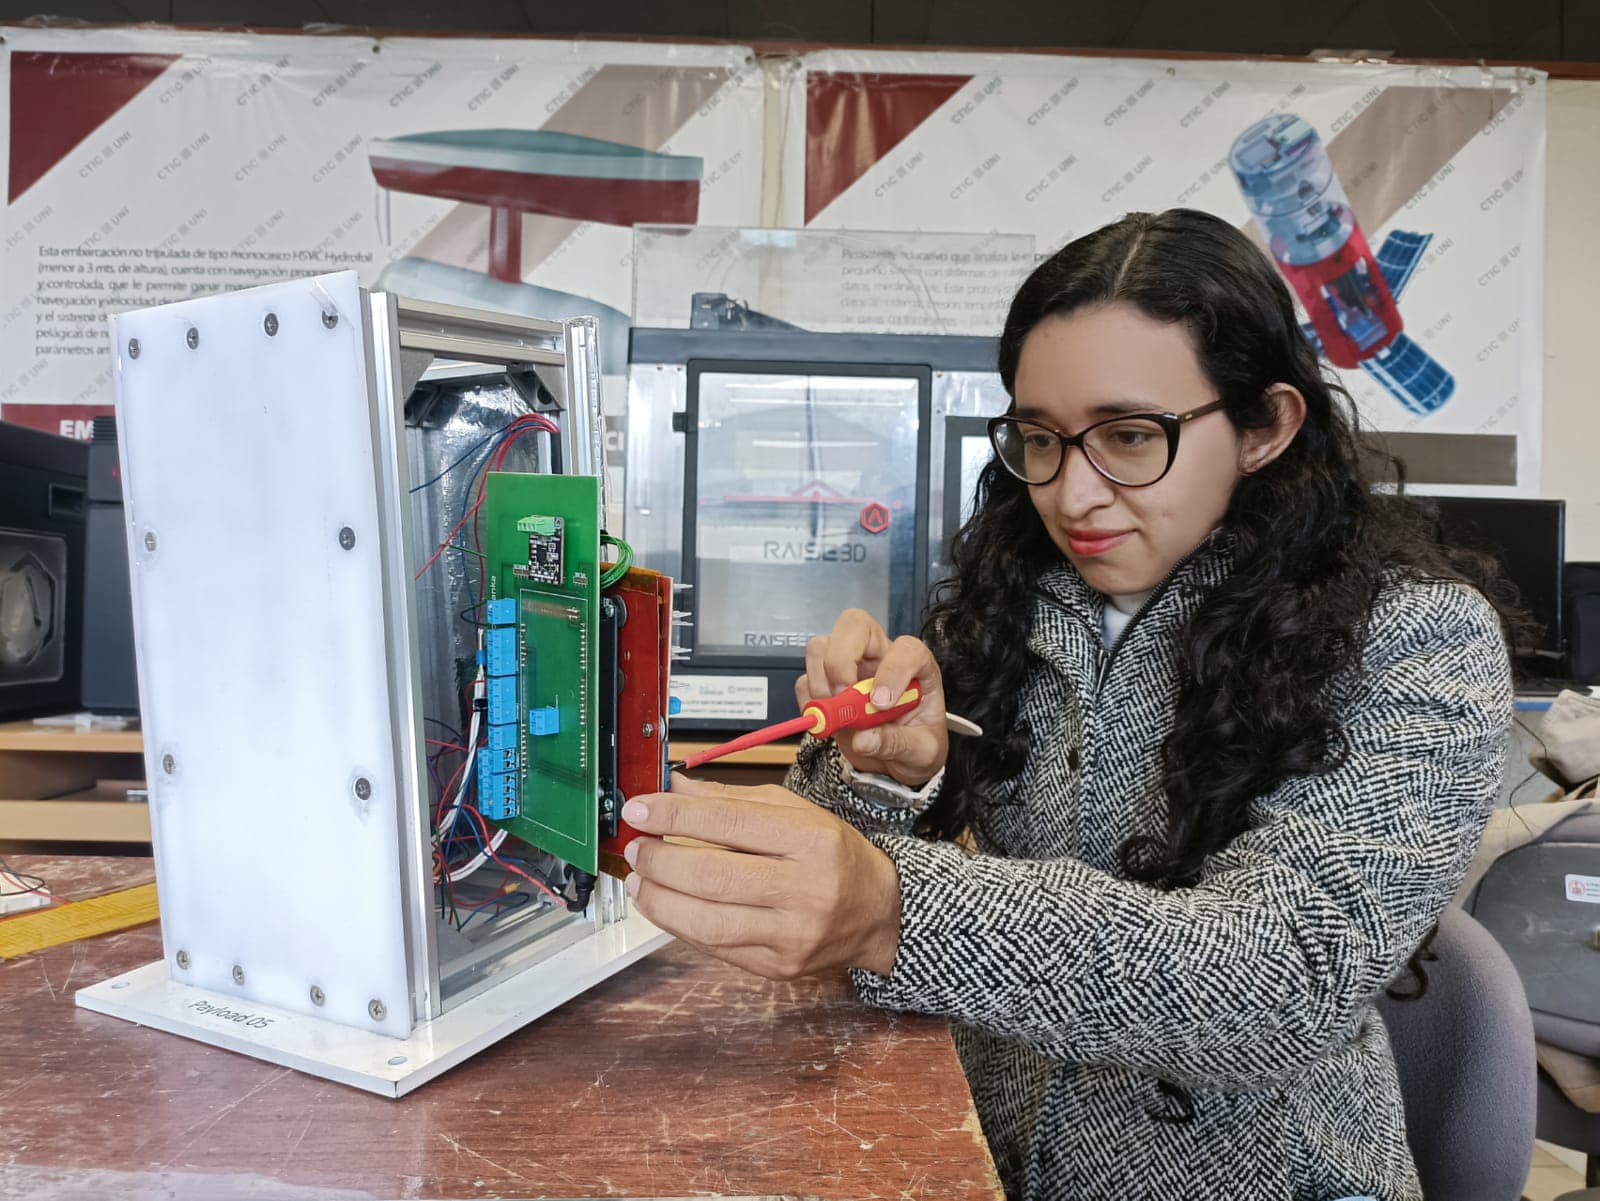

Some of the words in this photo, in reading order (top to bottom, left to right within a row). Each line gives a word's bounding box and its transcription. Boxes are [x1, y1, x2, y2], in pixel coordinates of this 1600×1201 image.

[389, 85, 415, 108] CTIC
[467, 88, 493, 111] CTIC
[500, 62, 521, 81] UNI
[544, 90, 570, 114] CTIC
[950, 100, 975, 124] CTIC
[1026, 102, 1052, 126] CTIC
[1059, 77, 1080, 96] UNI
[1330, 108, 1355, 133] CTIC
[1361, 86, 1382, 107] UNI
[1103, 103, 1129, 127] CTIC
[1179, 105, 1204, 128] CTIC
[1480, 111, 1505, 135] CTIC
[78, 154, 104, 178] CTIC
[111, 130, 133, 151] UNI
[156, 156, 182, 180] CTIC
[189, 131, 211, 152] UNI
[233, 158, 259, 181] CTIC
[311, 159, 337, 184] CTIC
[949, 176, 975, 200] CTIC
[981, 152, 1002, 171] UNI
[873, 175, 898, 198] CTIC
[1024, 178, 1049, 202] CTIC
[1100, 180, 1125, 202] CTIC
[1404, 184, 1429, 210] CTIC
[1435, 163, 1456, 182] UNI
[1479, 186, 1505, 211] CTIC
[109, 204, 130, 225] UNI
[187, 207, 208, 227] UNI
[39, 246, 59, 257] Esta
[192, 249, 207, 259] de
[207, 249, 230, 261] tipo
[1433, 237, 1456, 257] UNI
[77, 265, 85, 273] a
[86, 263, 94, 273] 3
[118, 263, 132, 273] de
[1477, 262, 1501, 287] CTIC
[108, 281, 130, 293] que
[132, 280, 143, 290] le
[36, 313, 43, 325] y
[44, 311, 55, 321] el
[85, 328, 100, 339] de
[1476, 338, 1500, 363] CTIC
[763, 540, 867, 564] RAISE3D
[187, 1000, 254, 1023] Payload
[245, 1016, 275, 1029] 05
